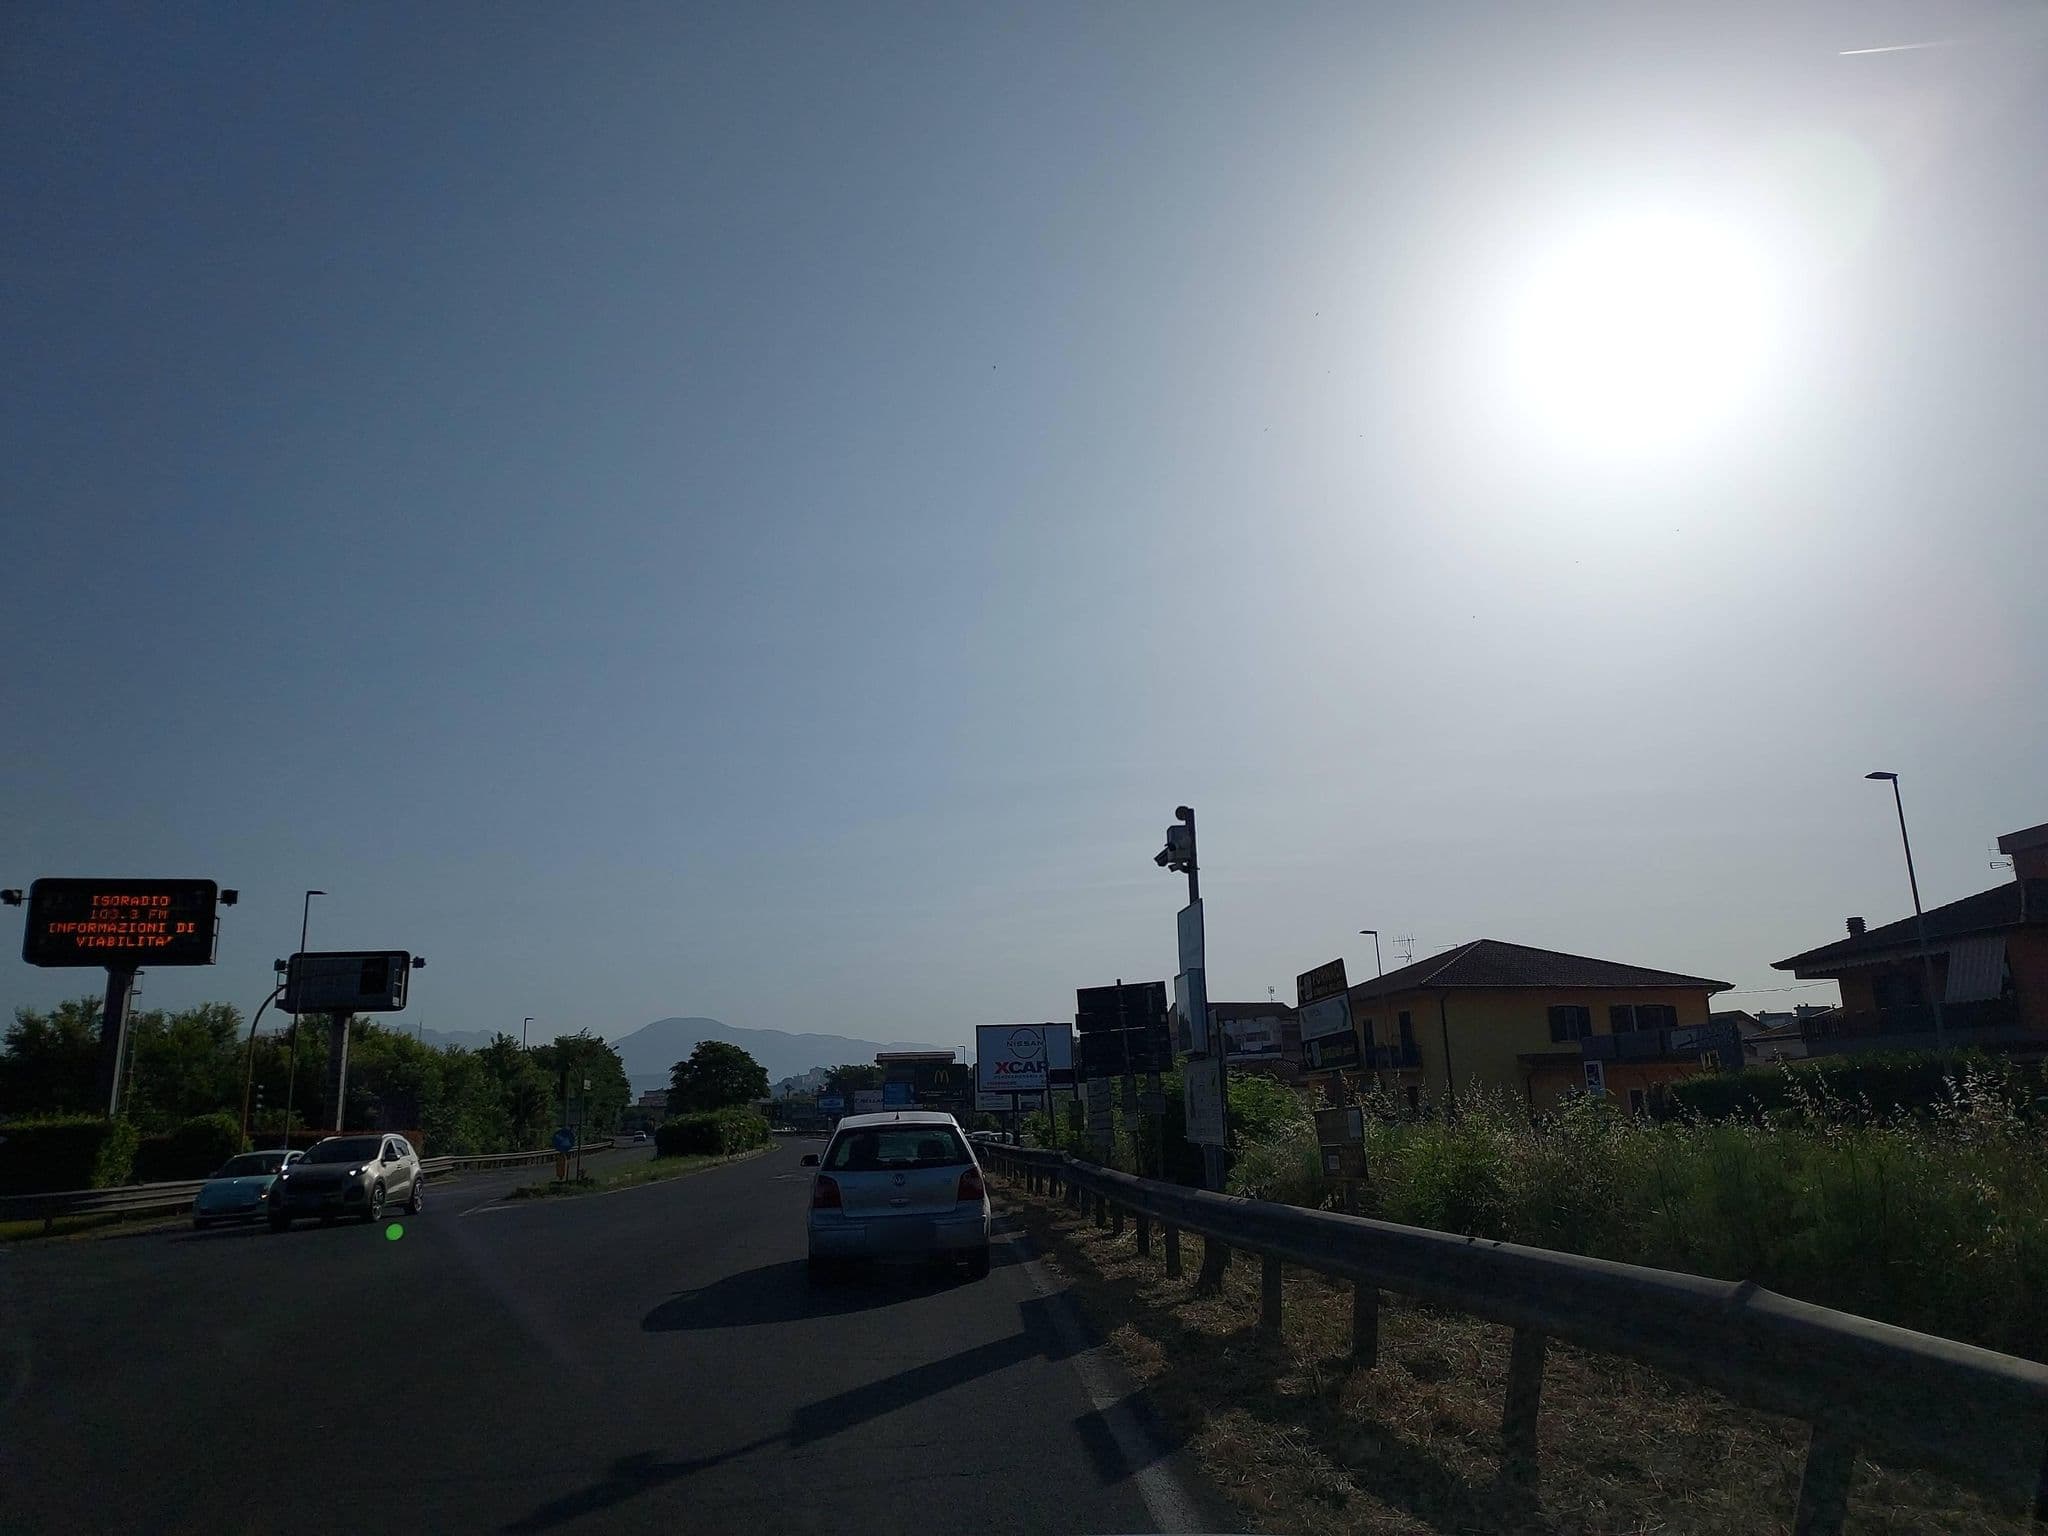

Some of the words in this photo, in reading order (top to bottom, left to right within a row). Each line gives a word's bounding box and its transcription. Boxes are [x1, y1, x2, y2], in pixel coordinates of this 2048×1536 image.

[92, 895, 170, 906] ISORADIO
[90, 908, 140, 919] 103.3
[147, 908, 168, 919] FM
[49, 922, 167, 933] INFORMAZIONI
[176, 922, 196, 933] DI
